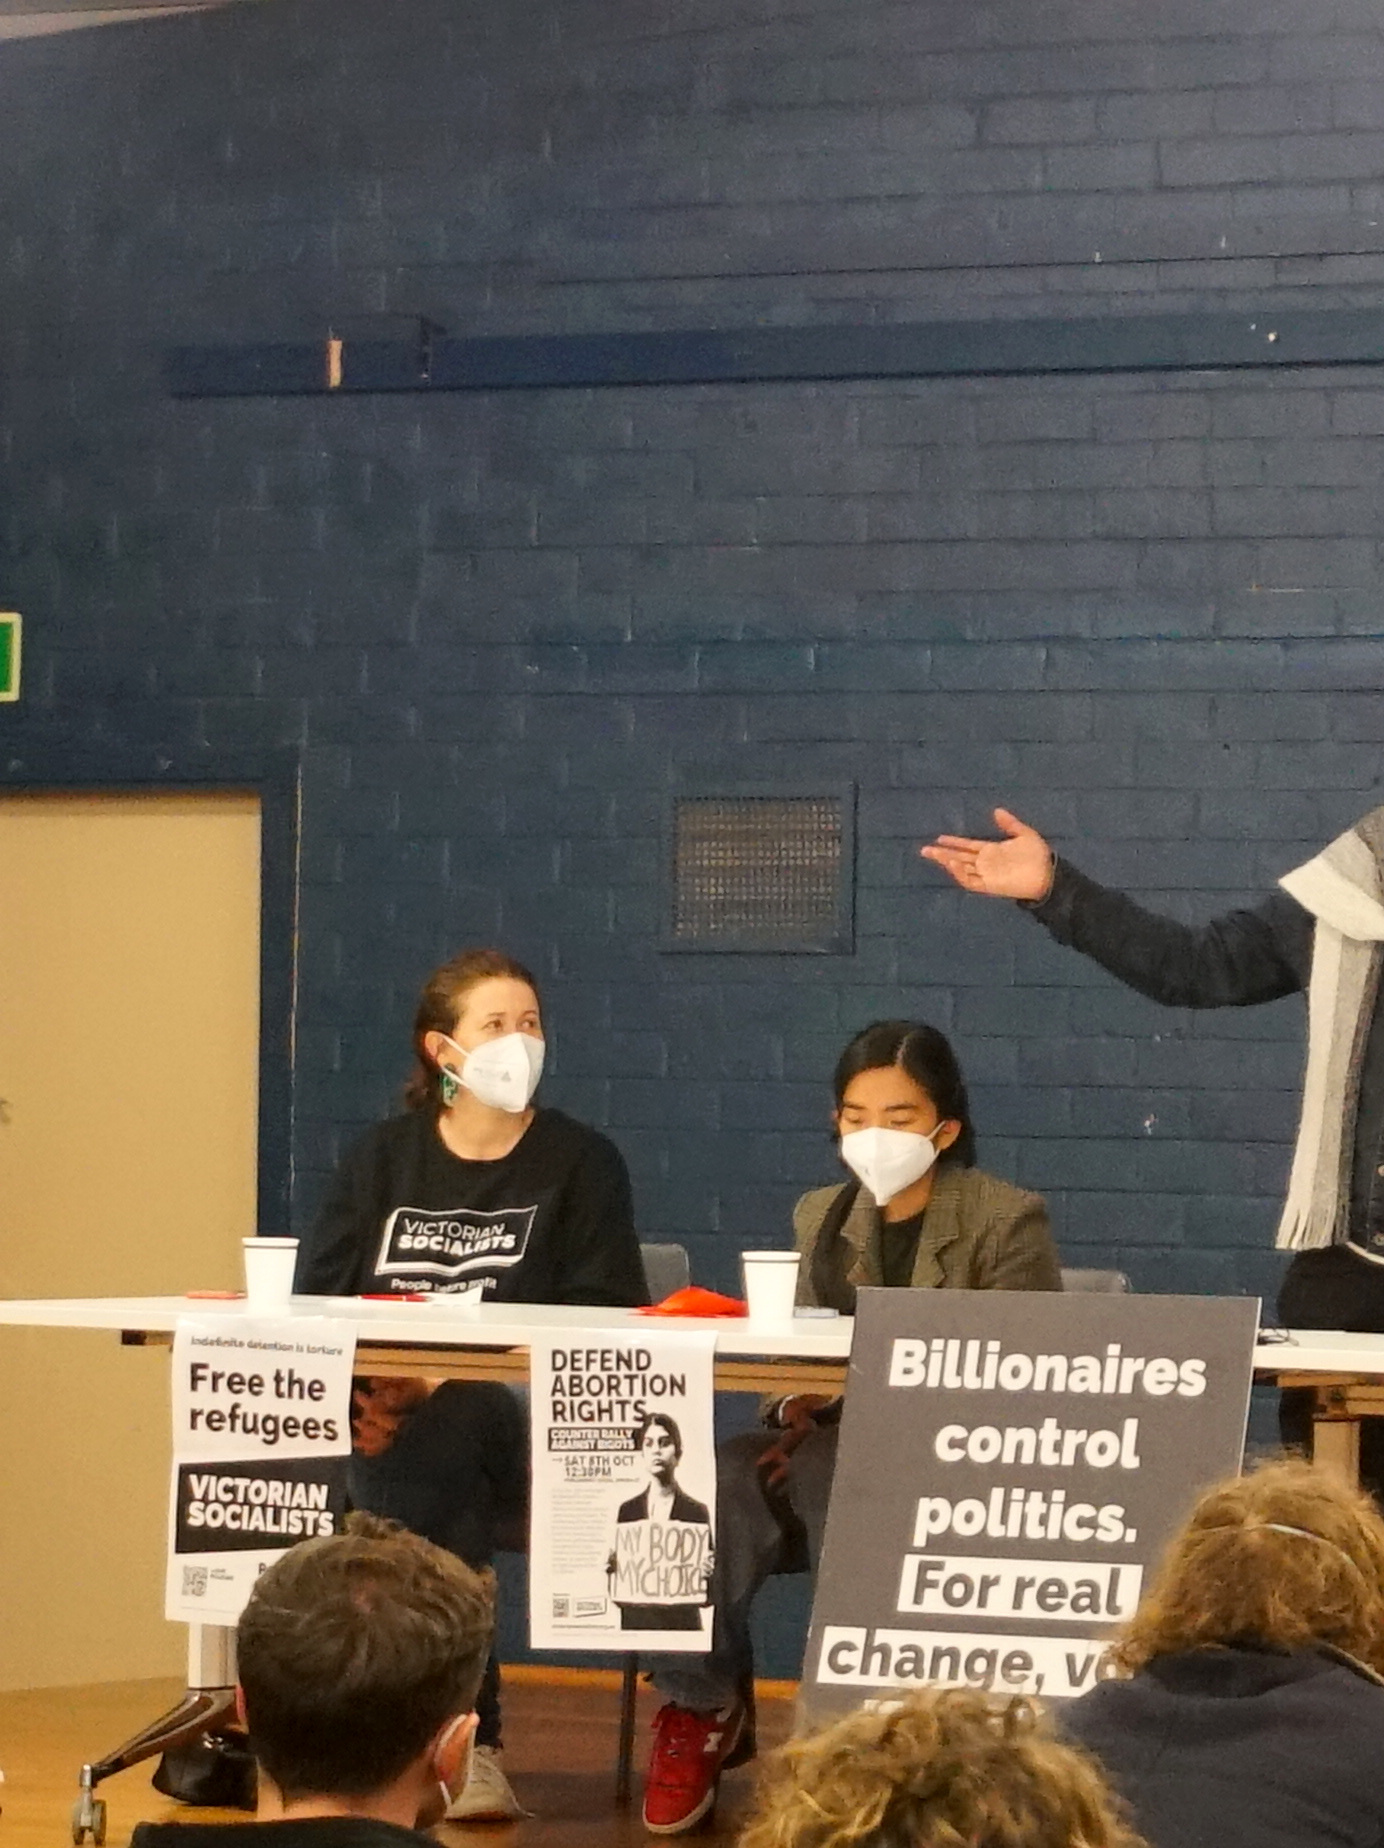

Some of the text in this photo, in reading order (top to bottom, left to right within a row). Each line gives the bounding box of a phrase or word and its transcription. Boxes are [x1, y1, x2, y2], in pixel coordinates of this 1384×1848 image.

[397, 1233, 517, 1257] SOCIALISTS
[403, 1217, 506, 1240] VICTORIAN
[190, 1335, 245, 1348] Indefinite
[246, 1341, 294, 1352] detention
[306, 1345, 343, 1355] torture
[551, 1349, 652, 1372] DEFEND
[190, 1362, 326, 1401] Free the
[551, 1373, 686, 1397] ABORTION
[889, 1338, 1207, 1396] Billionaires
[190, 1402, 339, 1445] refugees
[552, 1400, 647, 1422] RIGHTS
[551, 1429, 600, 1439] COUNTER
[551, 1439, 597, 1450] AGAINST
[935, 1418, 1141, 1469] control
[564, 1456, 587, 1467] SAT
[613, 1456, 635, 1467] OCT
[188, 1474, 329, 1510] VICTORIAN
[186, 1500, 335, 1537] SOCIALISTS
[913, 1487, 1137, 1548] politics.
[616, 1526, 642, 1556] MY
[649, 1523, 710, 1566] BODY
[613, 1558, 645, 1598] MY
[912, 1560, 1123, 1616] For real
[827, 1632, 1046, 1695] change,
